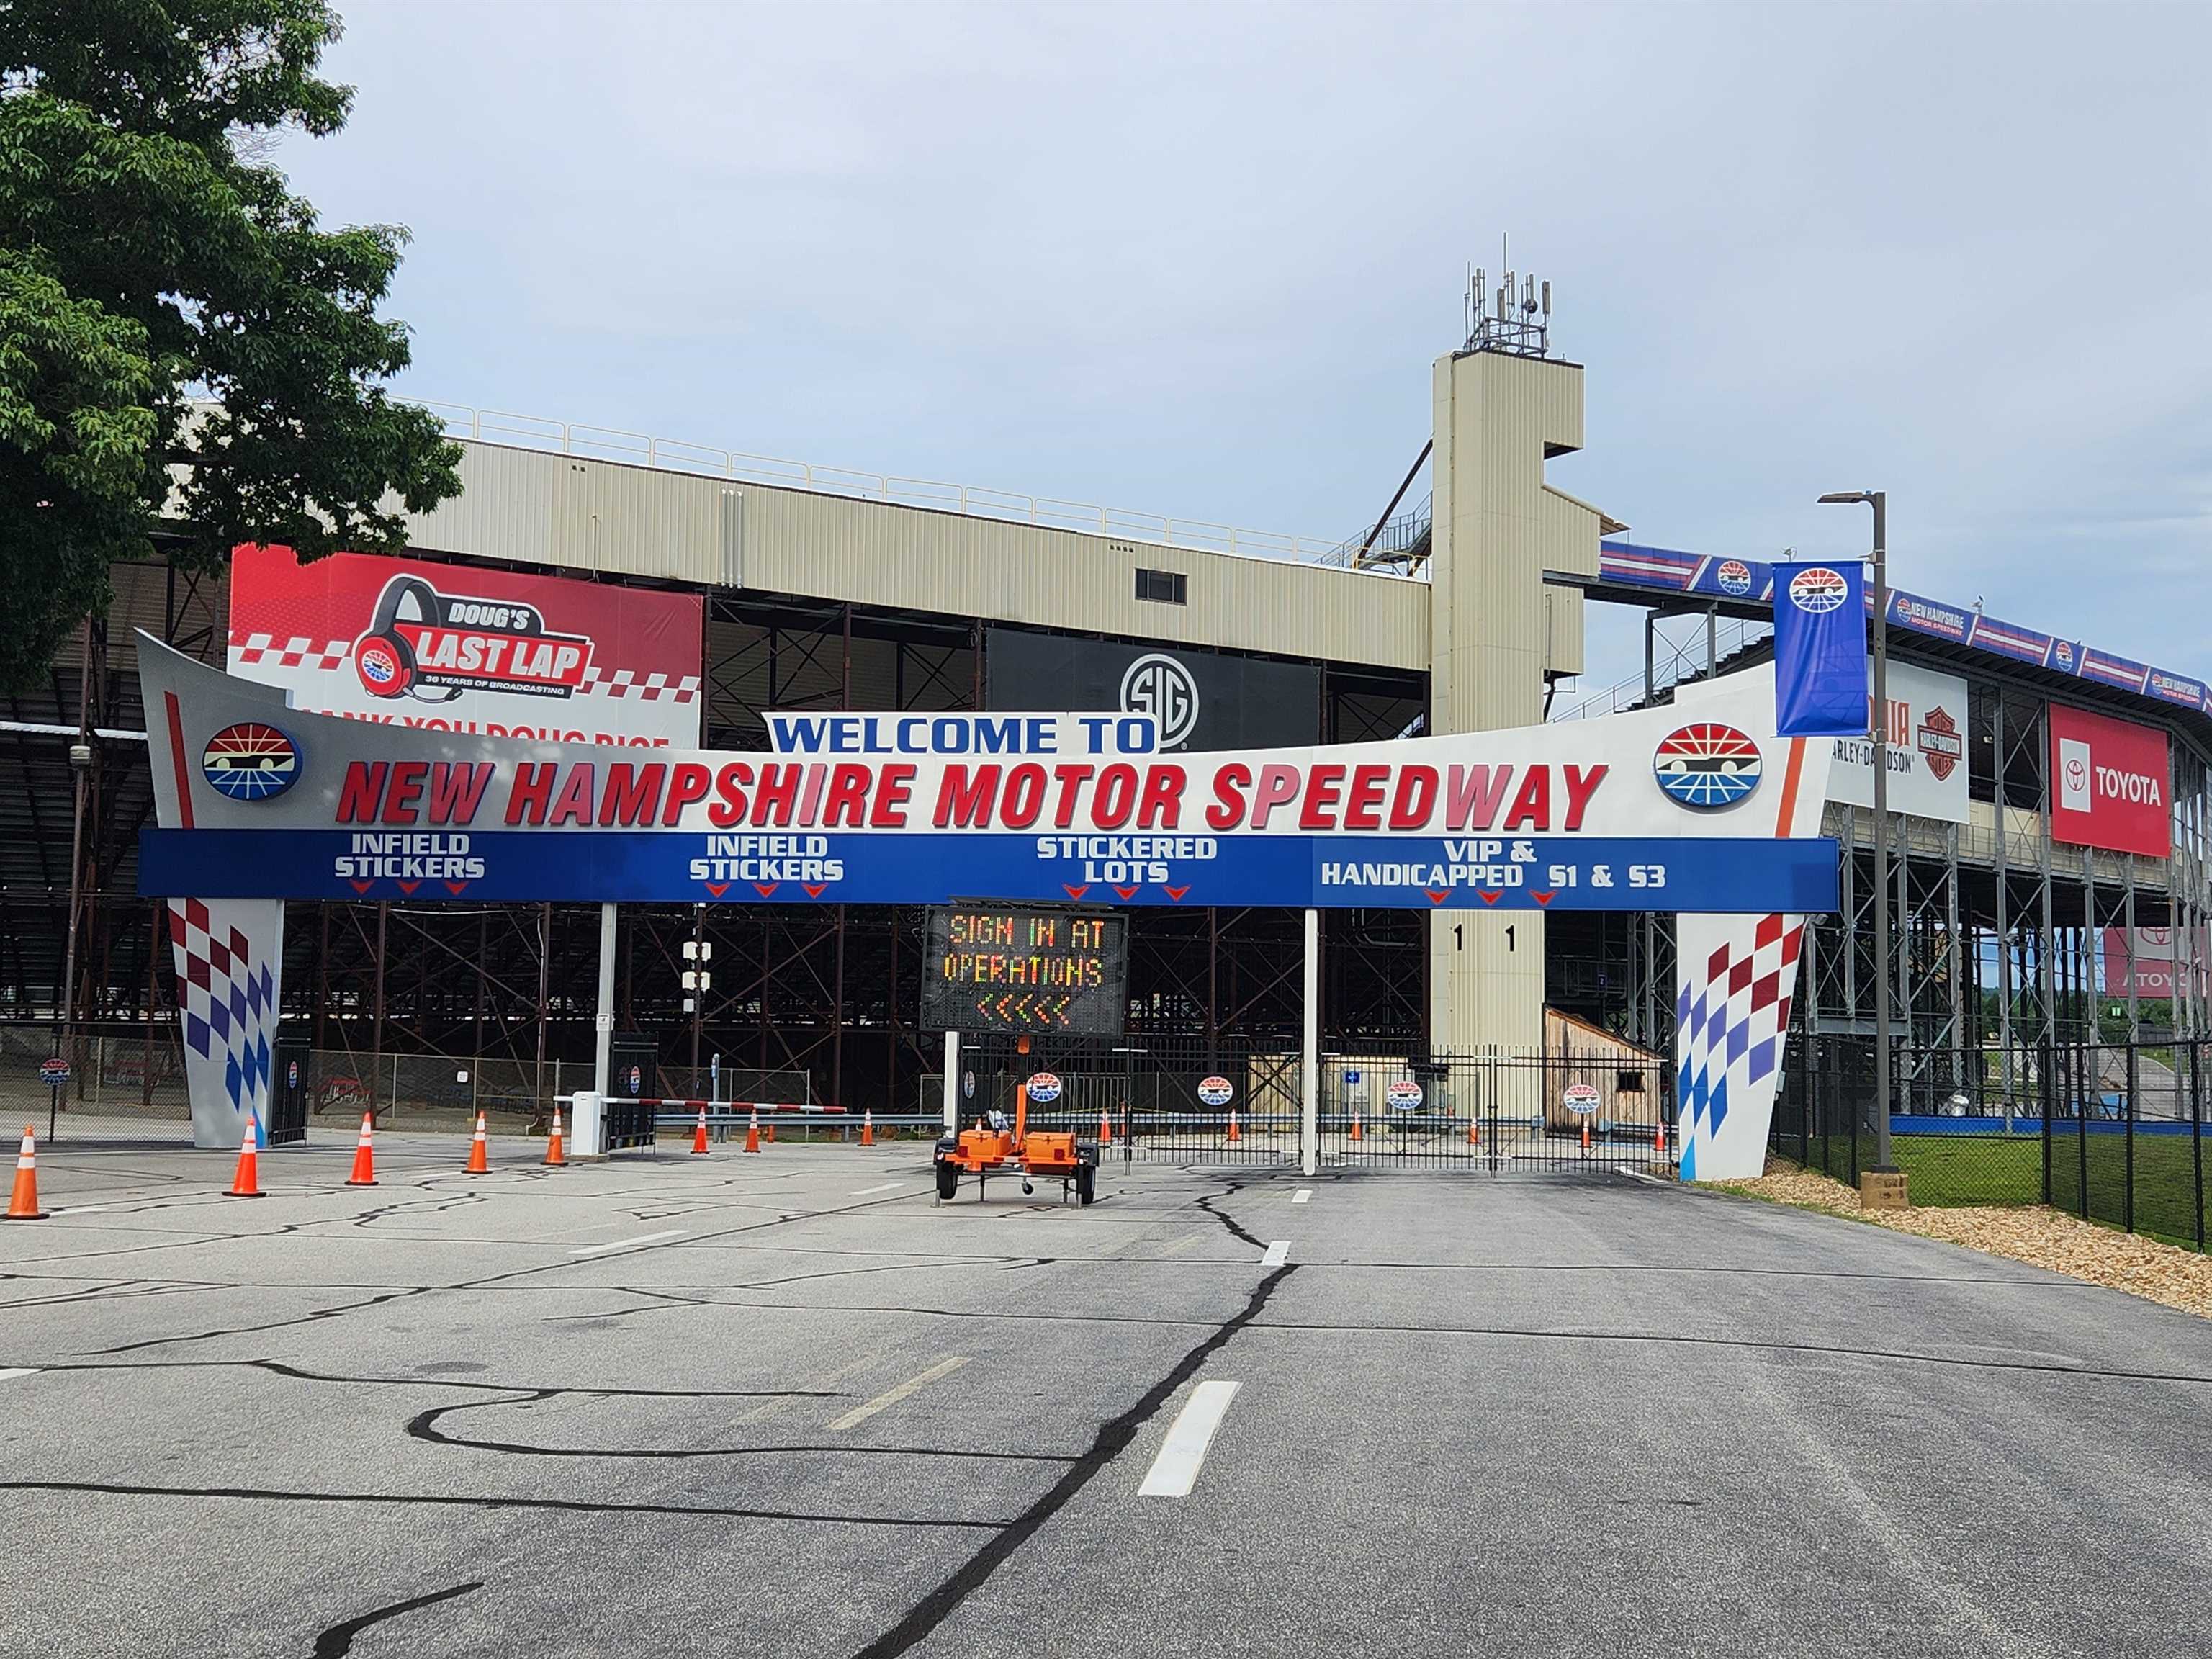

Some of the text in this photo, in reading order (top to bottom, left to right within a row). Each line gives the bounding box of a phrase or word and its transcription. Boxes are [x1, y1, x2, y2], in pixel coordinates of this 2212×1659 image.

[448, 603, 530, 630] DOUG'S
[1912, 602, 1964, 630] NEW HAMPSHIRE
[416, 631, 580, 680] LAST LAP
[441, 676, 473, 687] YEARS
[475, 679, 489, 688] OF
[490, 681, 565, 696] BROADCASTING
[1130, 667, 1188, 734] SIG
[772, 717, 1155, 754] WELCOME TO
[336, 761, 1610, 832] NEW HAMPSHIRE MOTOR SPEEDWAY
[2095, 765, 2162, 807] TOYOTA
[351, 833, 470, 855] INFIELD
[706, 835, 828, 857] INFIELD
[1036, 837, 1218, 860] STICKERED
[1443, 840, 1538, 863] VIP &
[335, 856, 485, 878] STICKERS
[689, 858, 844, 881] STICKERS
[1084, 861, 1169, 884] LOTS
[1321, 863, 1666, 888] HANDICAPPED S1 & S3
[949, 914, 1105, 949] SIGN IN AT
[1453, 924, 1462, 951] 1
[1505, 925, 1514, 952] 1
[943, 953, 1103, 988] OPERATIONS
